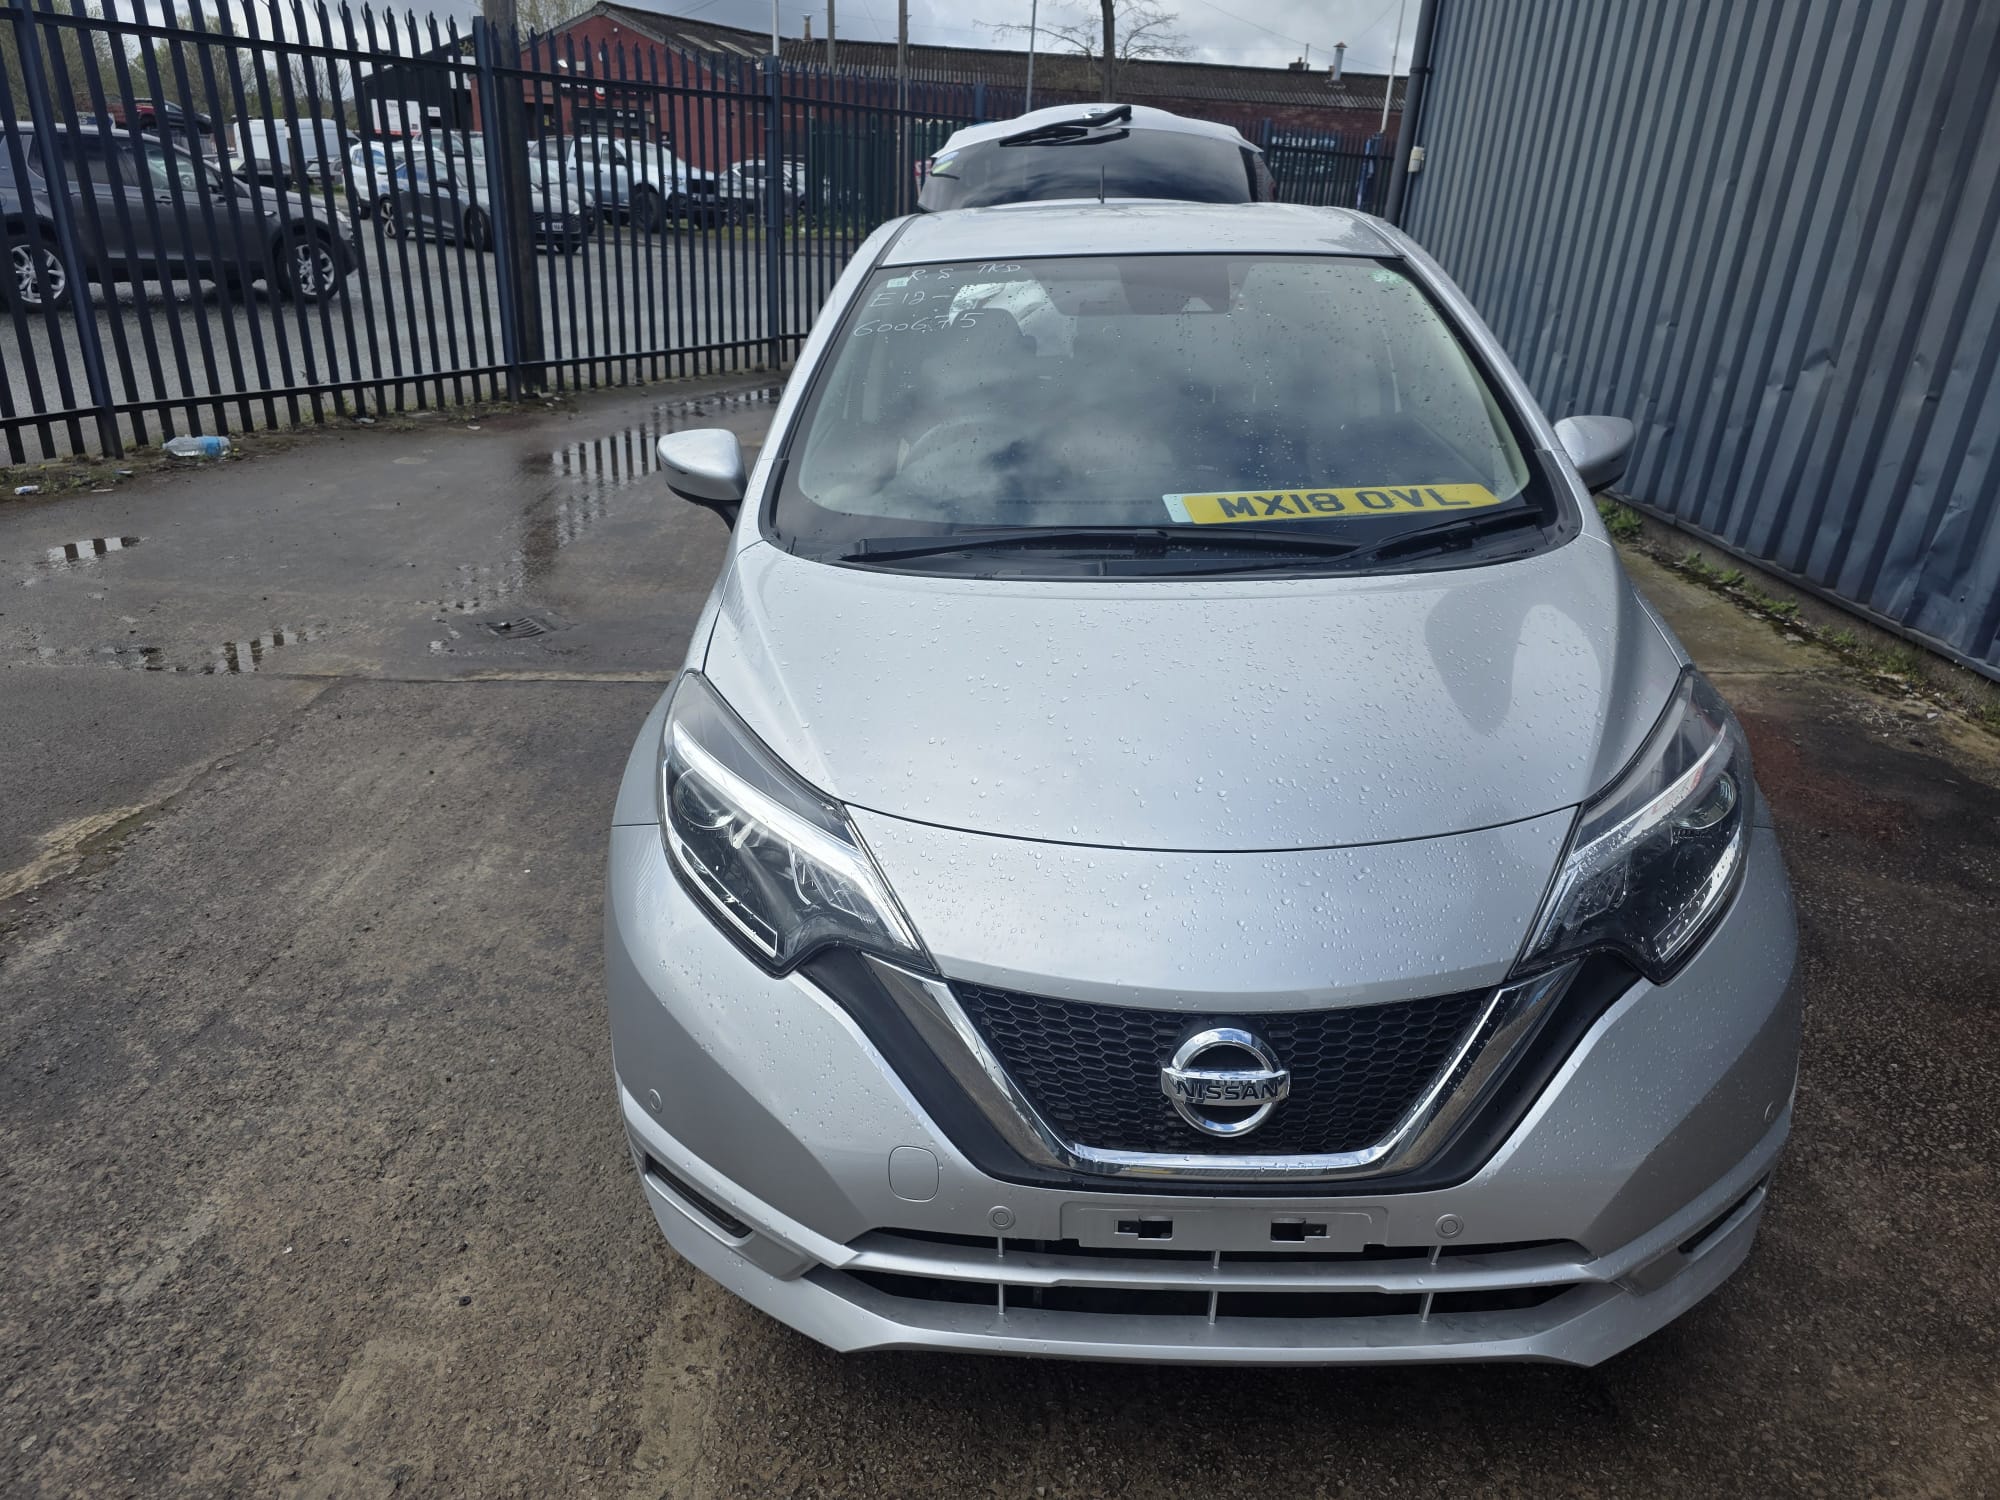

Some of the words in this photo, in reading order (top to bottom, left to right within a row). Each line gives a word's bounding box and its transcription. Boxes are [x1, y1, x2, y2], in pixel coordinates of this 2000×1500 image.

[1217, 492, 1345, 518] MX18
[1355, 488, 1471, 509] OVL
[1176, 1080, 1278, 1100] NISSAN
